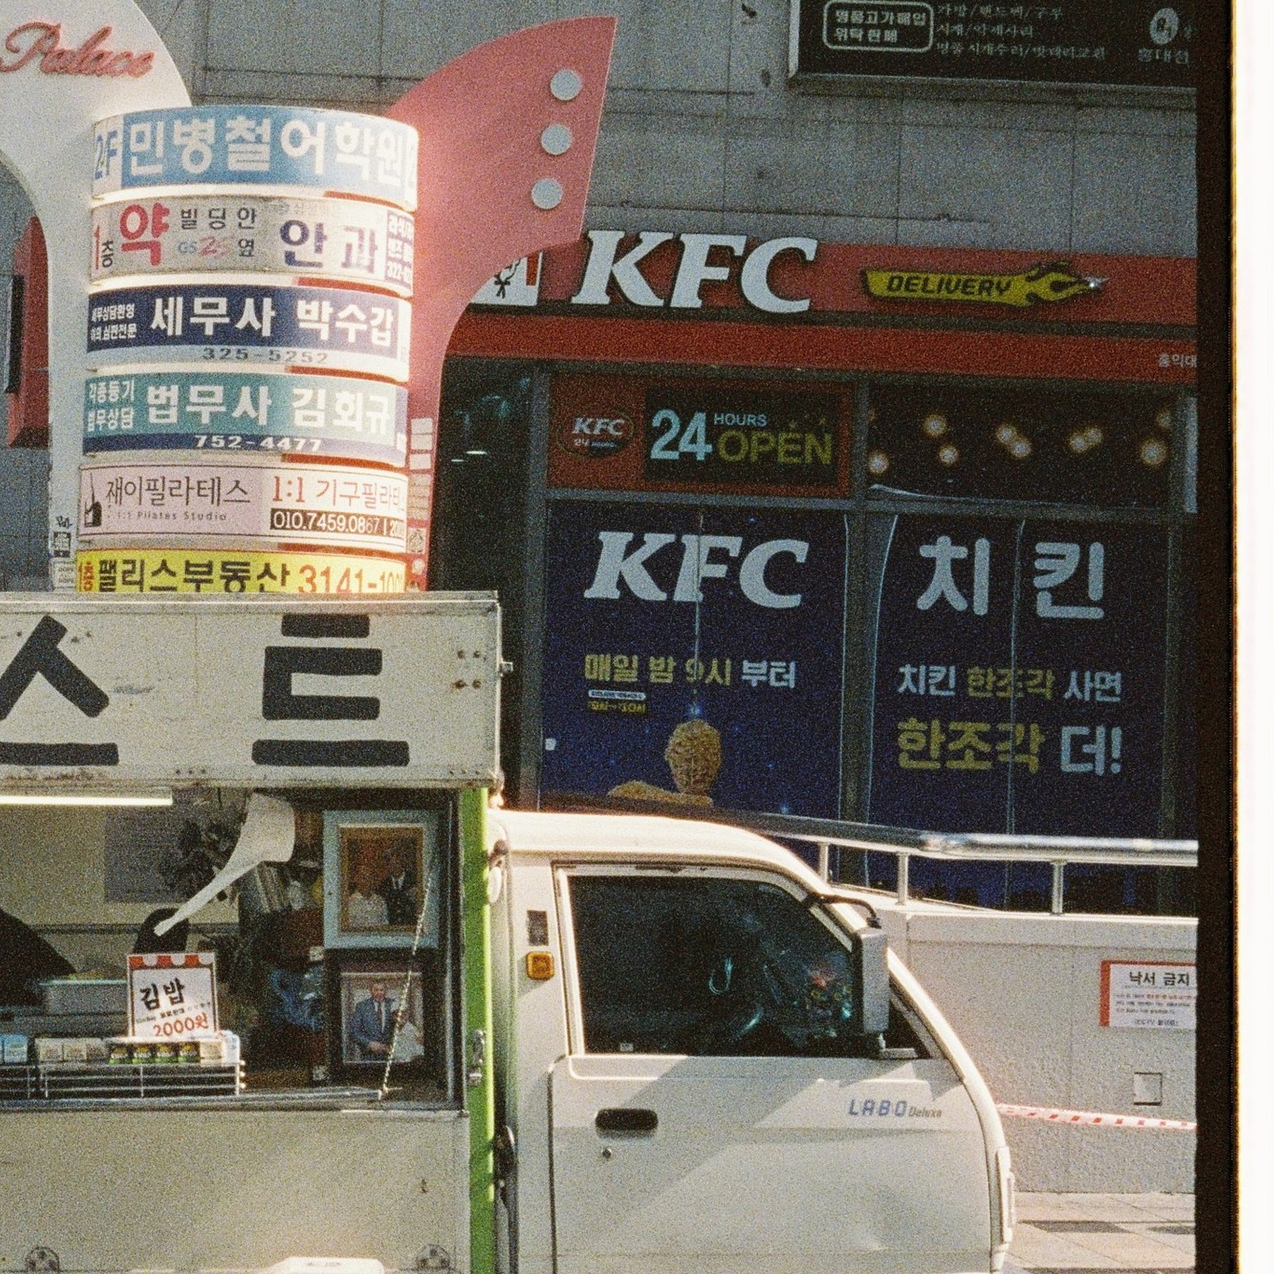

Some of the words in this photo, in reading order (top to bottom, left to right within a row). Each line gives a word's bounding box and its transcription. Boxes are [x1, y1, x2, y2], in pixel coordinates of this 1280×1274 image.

[129, 115, 402, 186] 민병철어학원
[120, 203, 170, 266] 약
[280, 219, 379, 274] 안과
[571, 229, 818, 313] KFC
[886, 274, 1013, 299] DELIVERY
[151, 296, 275, 338] 세무사
[296, 298, 394, 347] 박수갑
[202, 345, 329, 364] 325-5252
[146, 384, 272, 426] 법무사
[291, 386, 390, 435] 김회규
[572, 417, 625, 436] KFC
[195, 434, 322, 452] 752-4477
[650, 408, 713, 461] 24
[713, 412, 768, 427] HOURS
[718, 430, 832, 466] OPEN
[105, 475, 251, 507] 재이필라테스
[273, 476, 305, 503] 1:1
[137, 511, 177, 520] Pilates
[184, 511, 227, 521] Studio
[582, 530, 809, 609] KFC
[916, 536, 1105, 620] 치킨
[584, 653, 639, 683] 매일
[649, 655, 677, 684] 밤
[685, 658, 732, 687] 9시
[741, 659, 797, 689] 부터
[897, 662, 956, 697] 치킨
[967, 666, 1056, 701] 한조각
[1062, 669, 1122, 704] 사면
[896, 717, 1046, 775] 한조각
[1059, 722, 1122, 777] 더!
[140, 977, 185, 1011] 김밥
[1129, 970, 1156, 986] 낙서
[1163, 971, 1190, 986] 금지
[153, 1012, 209, 1037] 2000원
[848, 1099, 907, 1117] LABO
